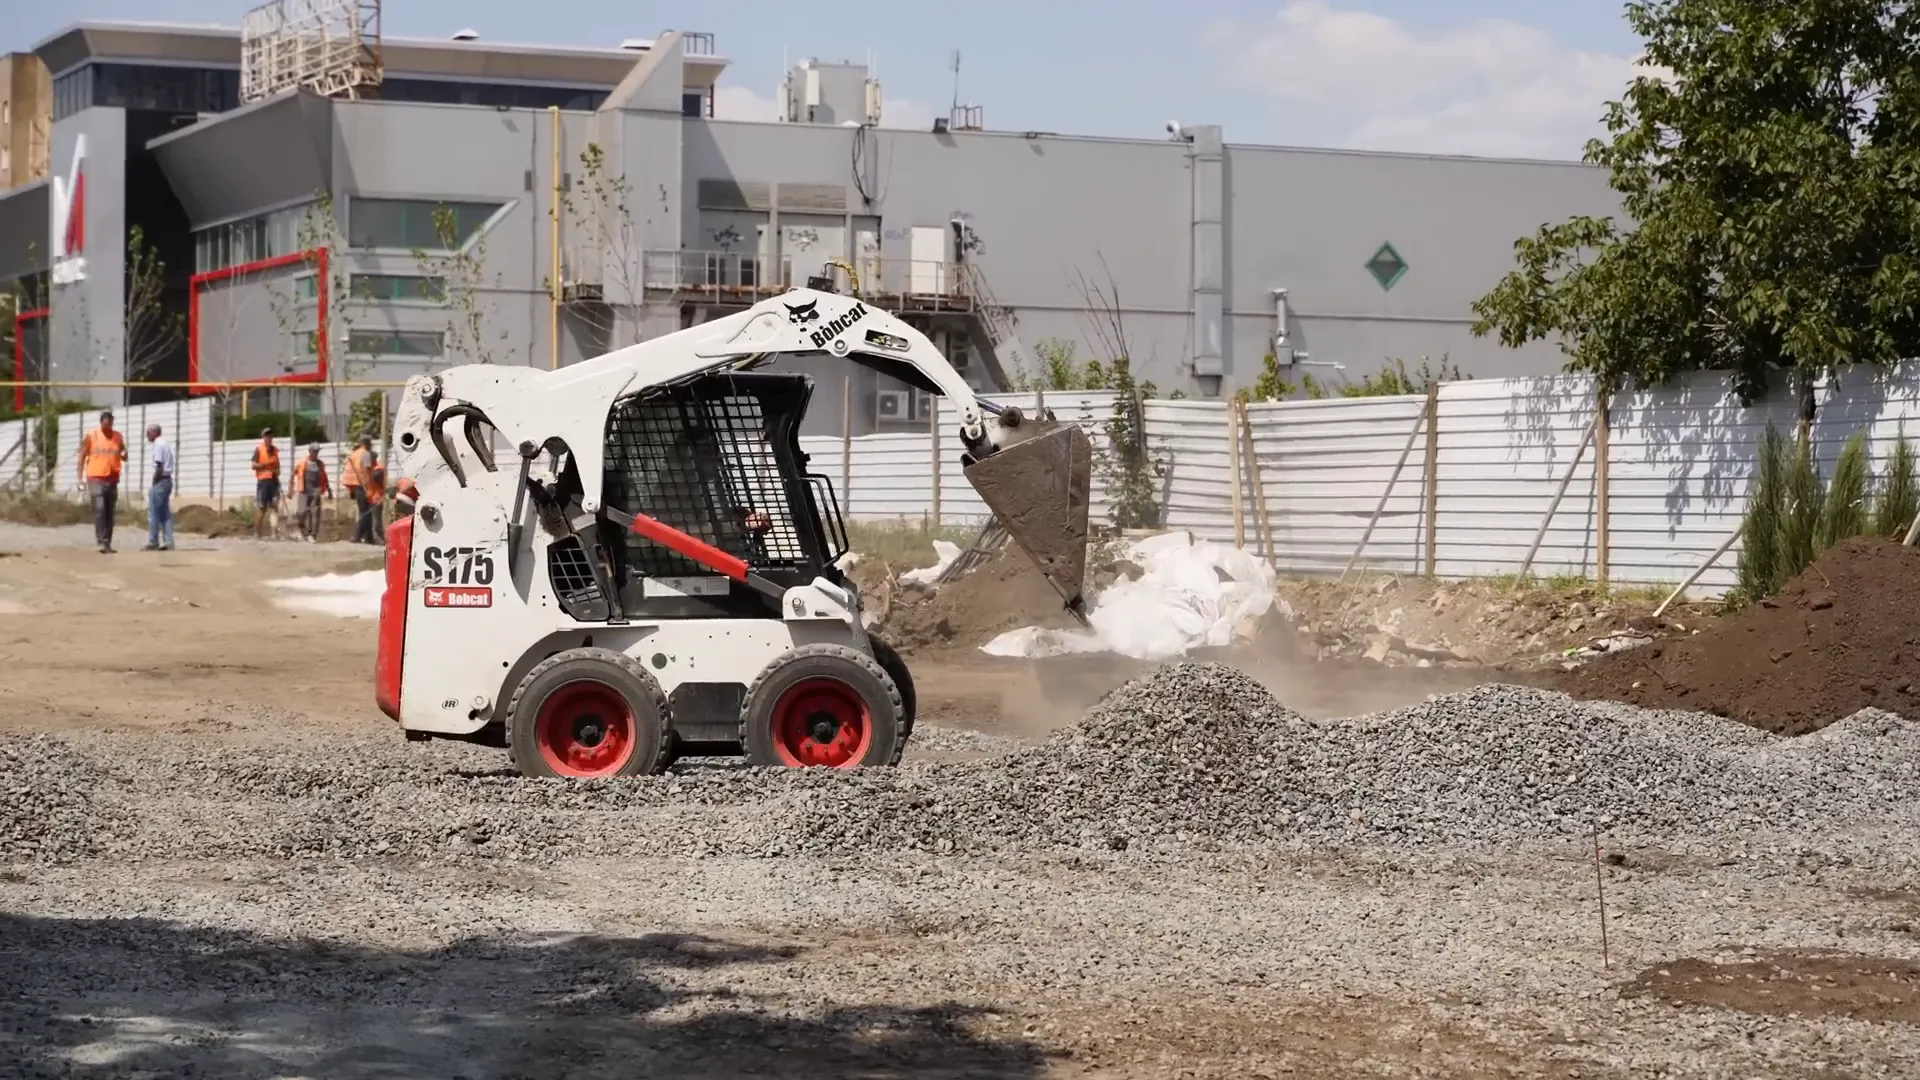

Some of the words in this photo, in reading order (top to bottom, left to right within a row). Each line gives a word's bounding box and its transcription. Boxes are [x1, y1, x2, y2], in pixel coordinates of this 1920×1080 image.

[809, 302, 868, 348] Bobcat
[423, 546, 494, 585] S175
[448, 592, 489, 606] Bobcat
[444, 699, 457, 708] IR
